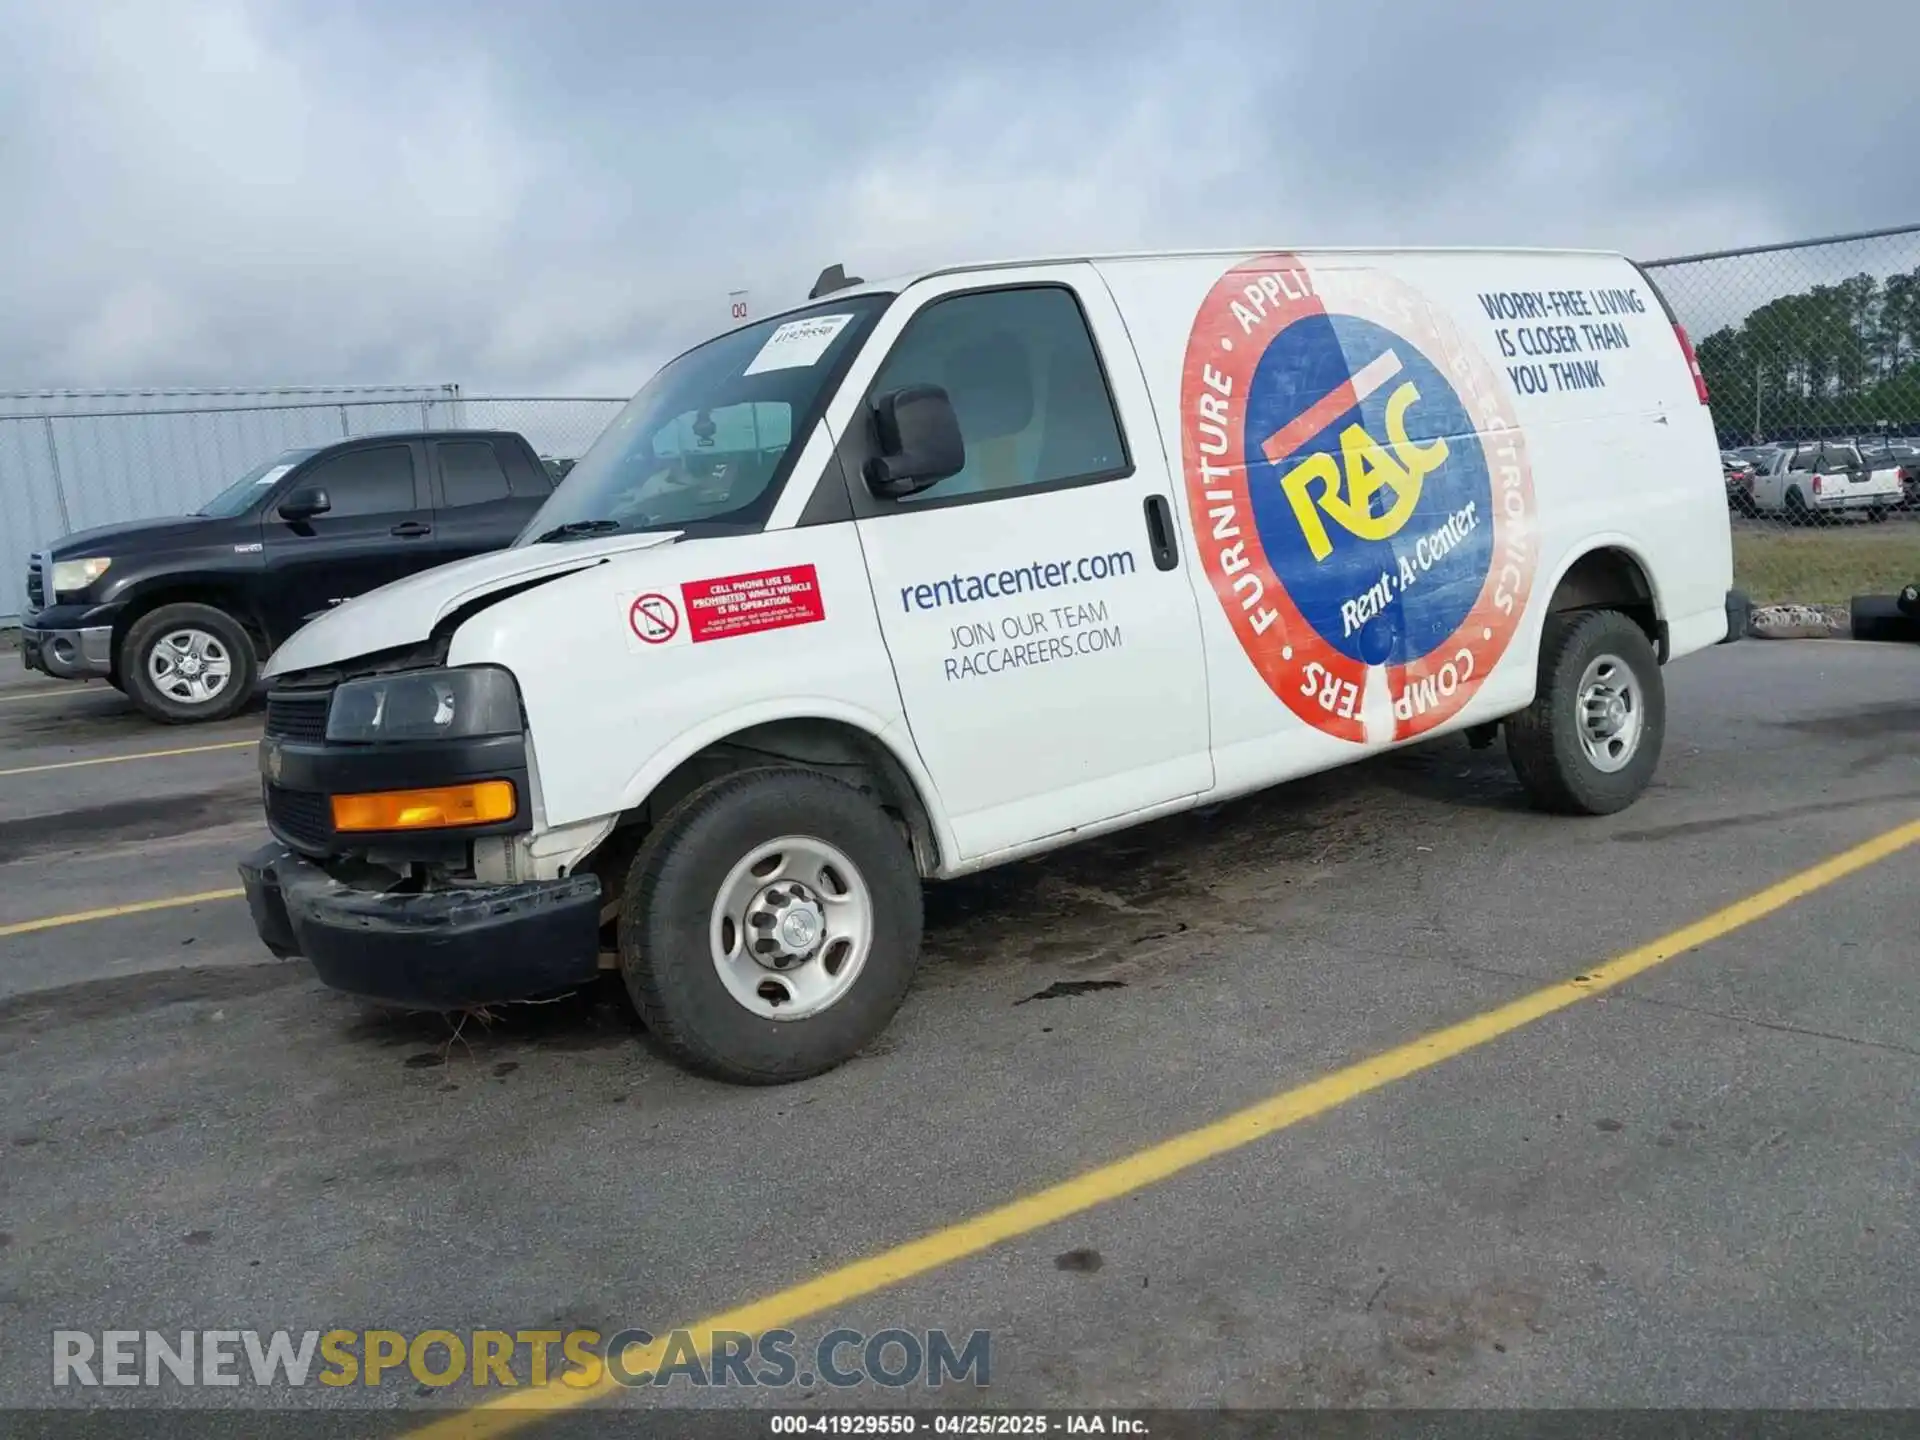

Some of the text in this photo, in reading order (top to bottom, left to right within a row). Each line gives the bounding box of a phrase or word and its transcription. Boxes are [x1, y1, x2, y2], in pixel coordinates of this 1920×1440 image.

[1477, 287, 1646, 321] WORRY-FREE LIVING
[1494, 322, 1631, 358] IS CLOSER THAN
[1506, 359, 1606, 396] YOU THINK
[1280, 381, 1450, 562] RAC
[1199, 363, 1278, 636] FURNITURE
[692, 582, 812, 609] PROHIBITED WHILE VEHICLE
[710, 574, 792, 595] CELL PHONE USE IS
[900, 549, 1136, 613] rentacenter.com
[717, 606, 727, 614] IS
[728, 604, 739, 613] IN
[950, 600, 1109, 650] JOIN OUR TEAM
[944, 625, 1123, 681] RACCAREERS.COM
